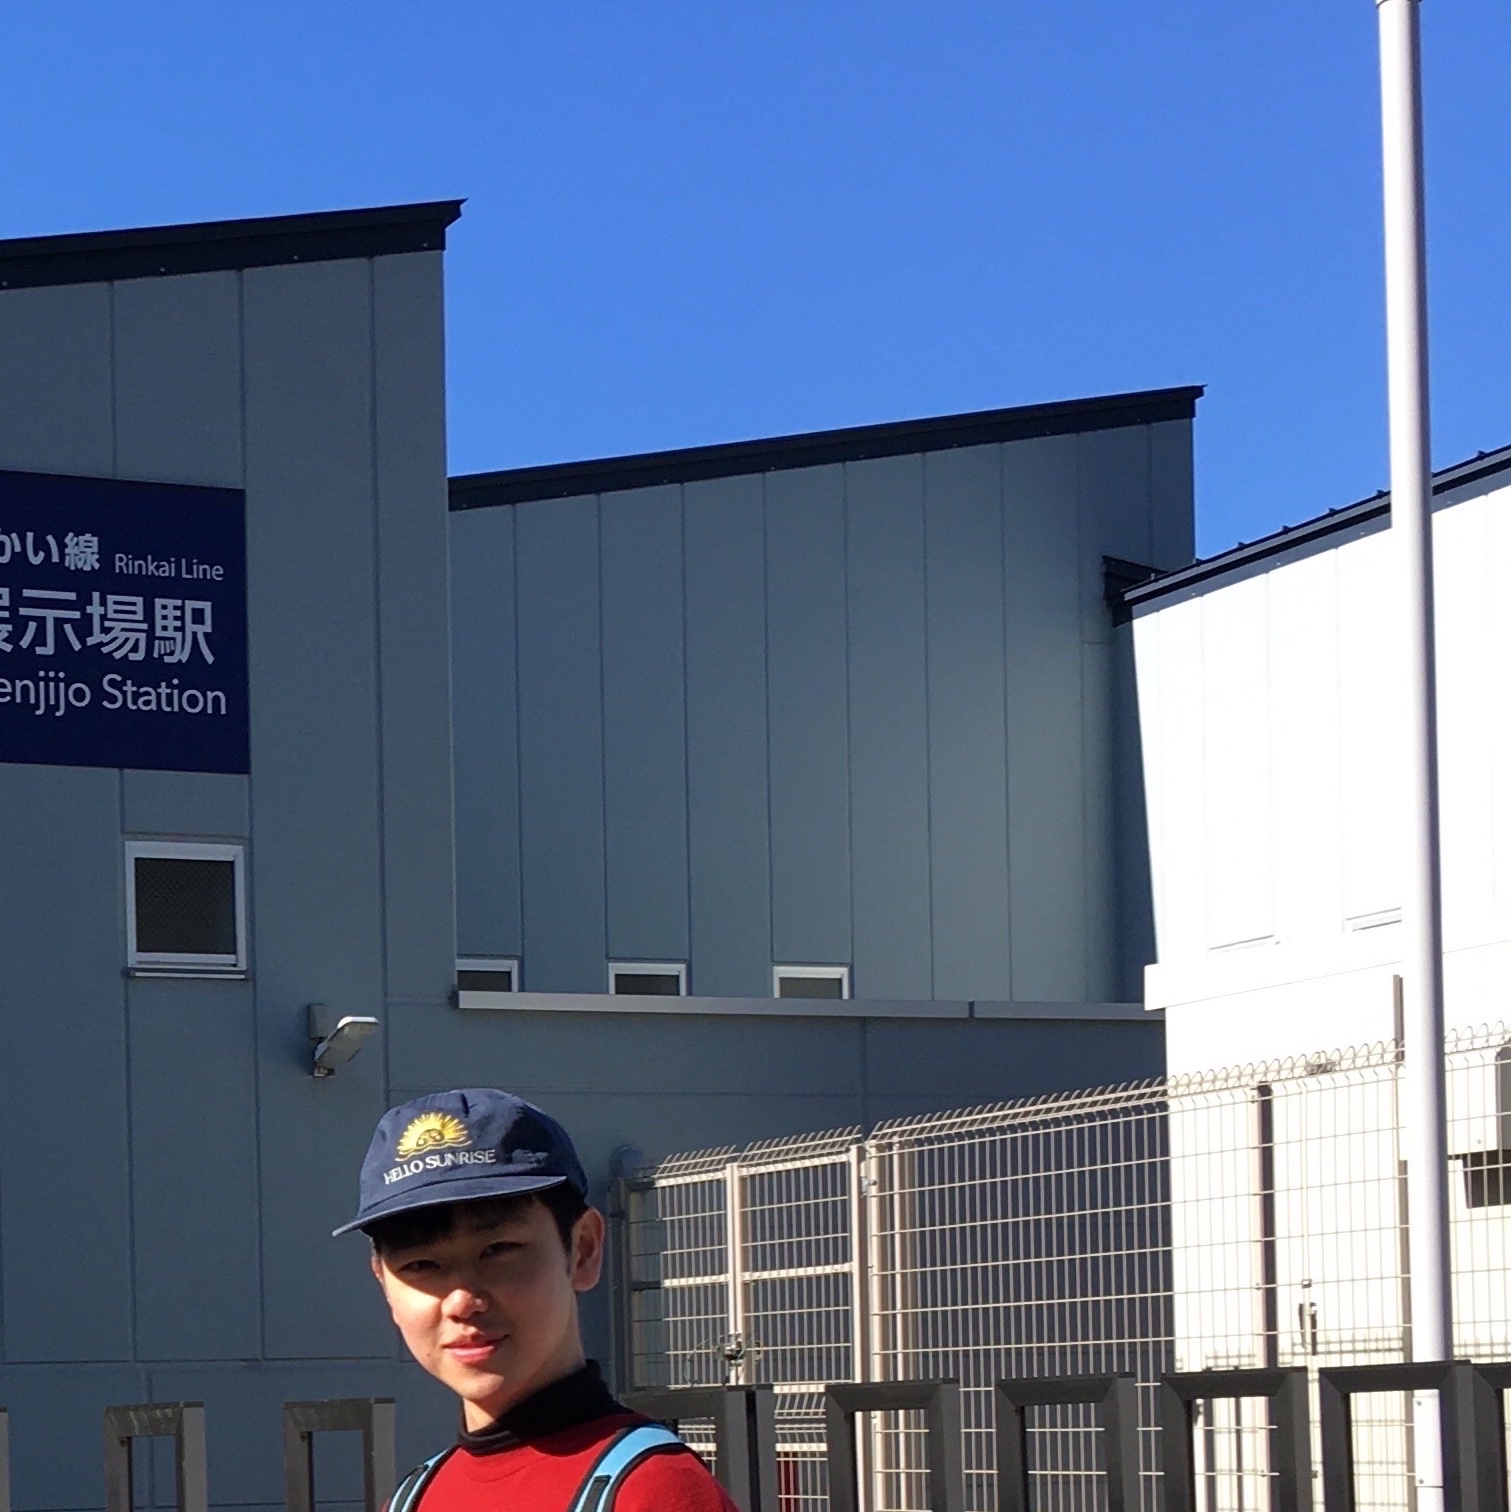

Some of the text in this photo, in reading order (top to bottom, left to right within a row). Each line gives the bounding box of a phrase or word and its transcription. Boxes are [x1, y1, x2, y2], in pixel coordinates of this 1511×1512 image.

[114, 553, 176, 578] Rinkai
[181, 557, 225, 581] Line
[101, 673, 227, 715] Station
[383, 1149, 496, 1185] HELLO SUNRISE
